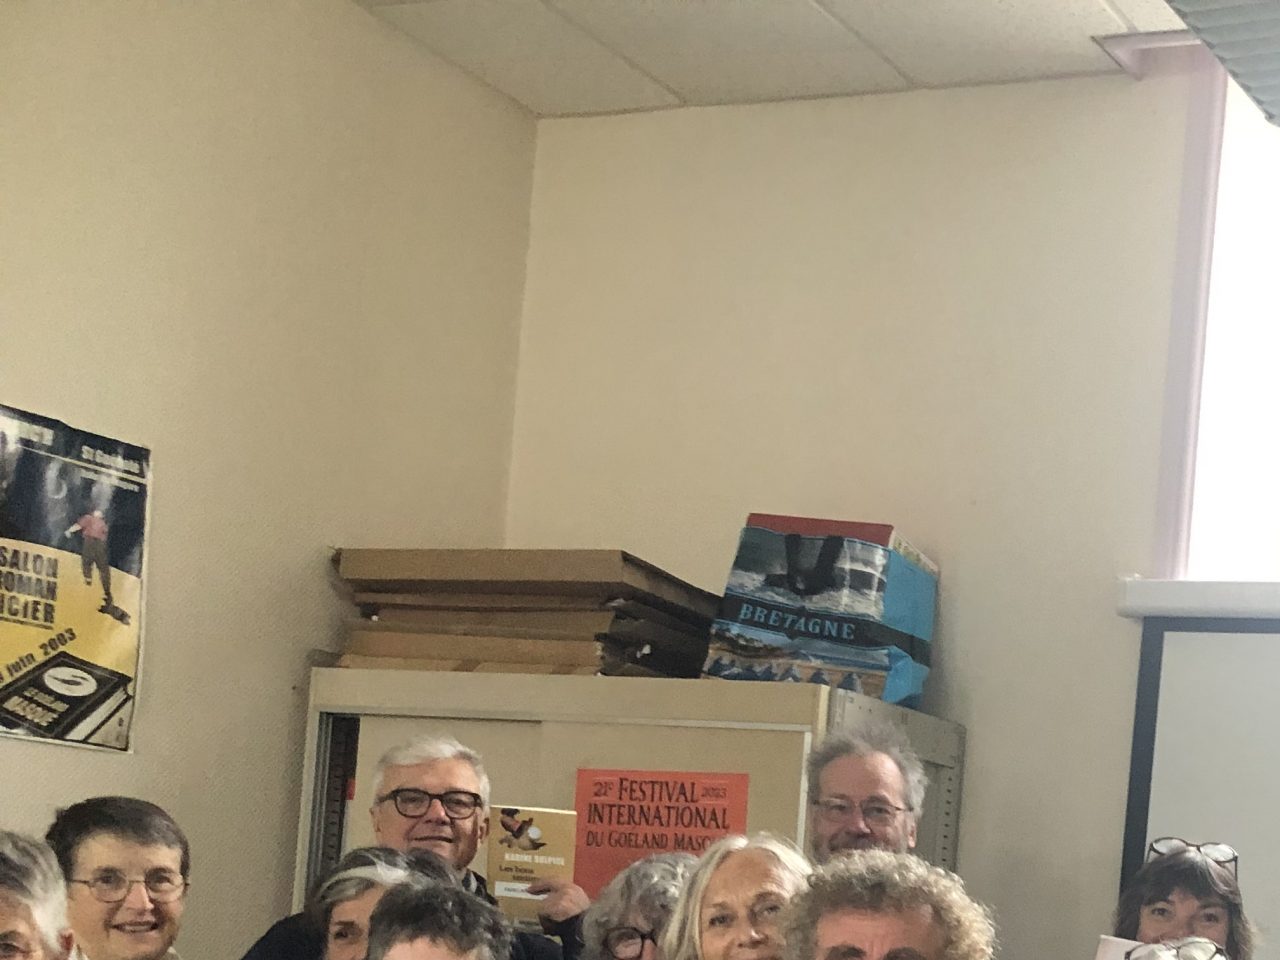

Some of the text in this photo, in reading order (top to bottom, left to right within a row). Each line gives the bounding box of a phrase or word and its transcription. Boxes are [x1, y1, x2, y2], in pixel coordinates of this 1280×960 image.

[0, 592, 55, 625] ICIER
[739, 603, 856, 640] BRETAGNE
[618, 777, 699, 804] FESTIVAL
[586, 803, 731, 830] INTERNATIONAL
[586, 830, 604, 847] DU
[608, 830, 669, 849] GOELAND
